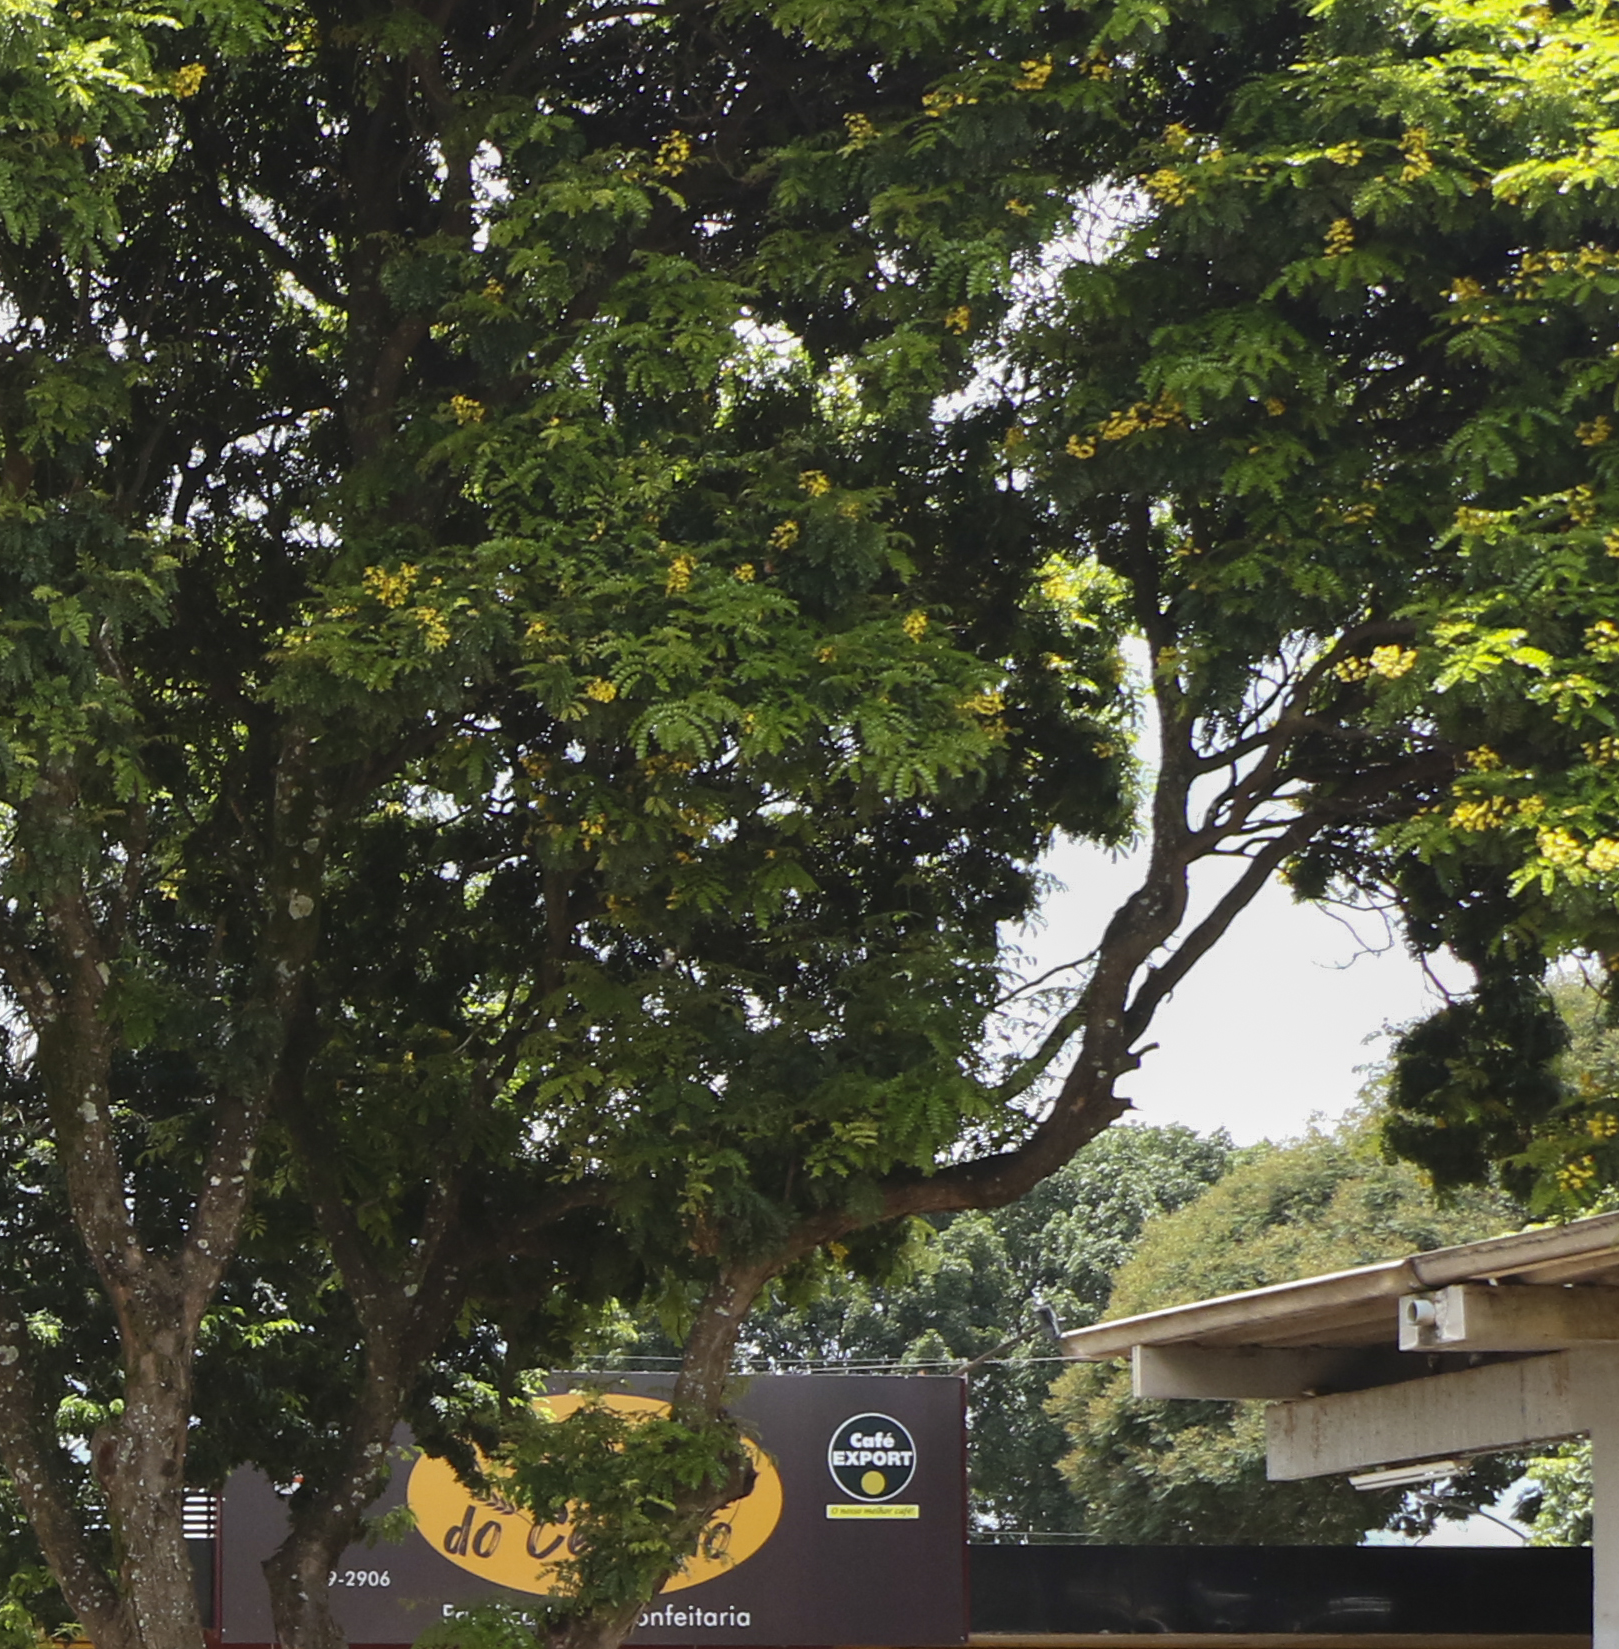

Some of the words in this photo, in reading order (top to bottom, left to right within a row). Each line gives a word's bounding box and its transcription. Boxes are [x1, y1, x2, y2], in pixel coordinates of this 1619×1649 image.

[849, 1431, 896, 1449] Café
[832, 1450, 913, 1467] EXPORT
[444, 1505, 503, 1560] do
[637, 1603, 752, 1628] onfeitaria
